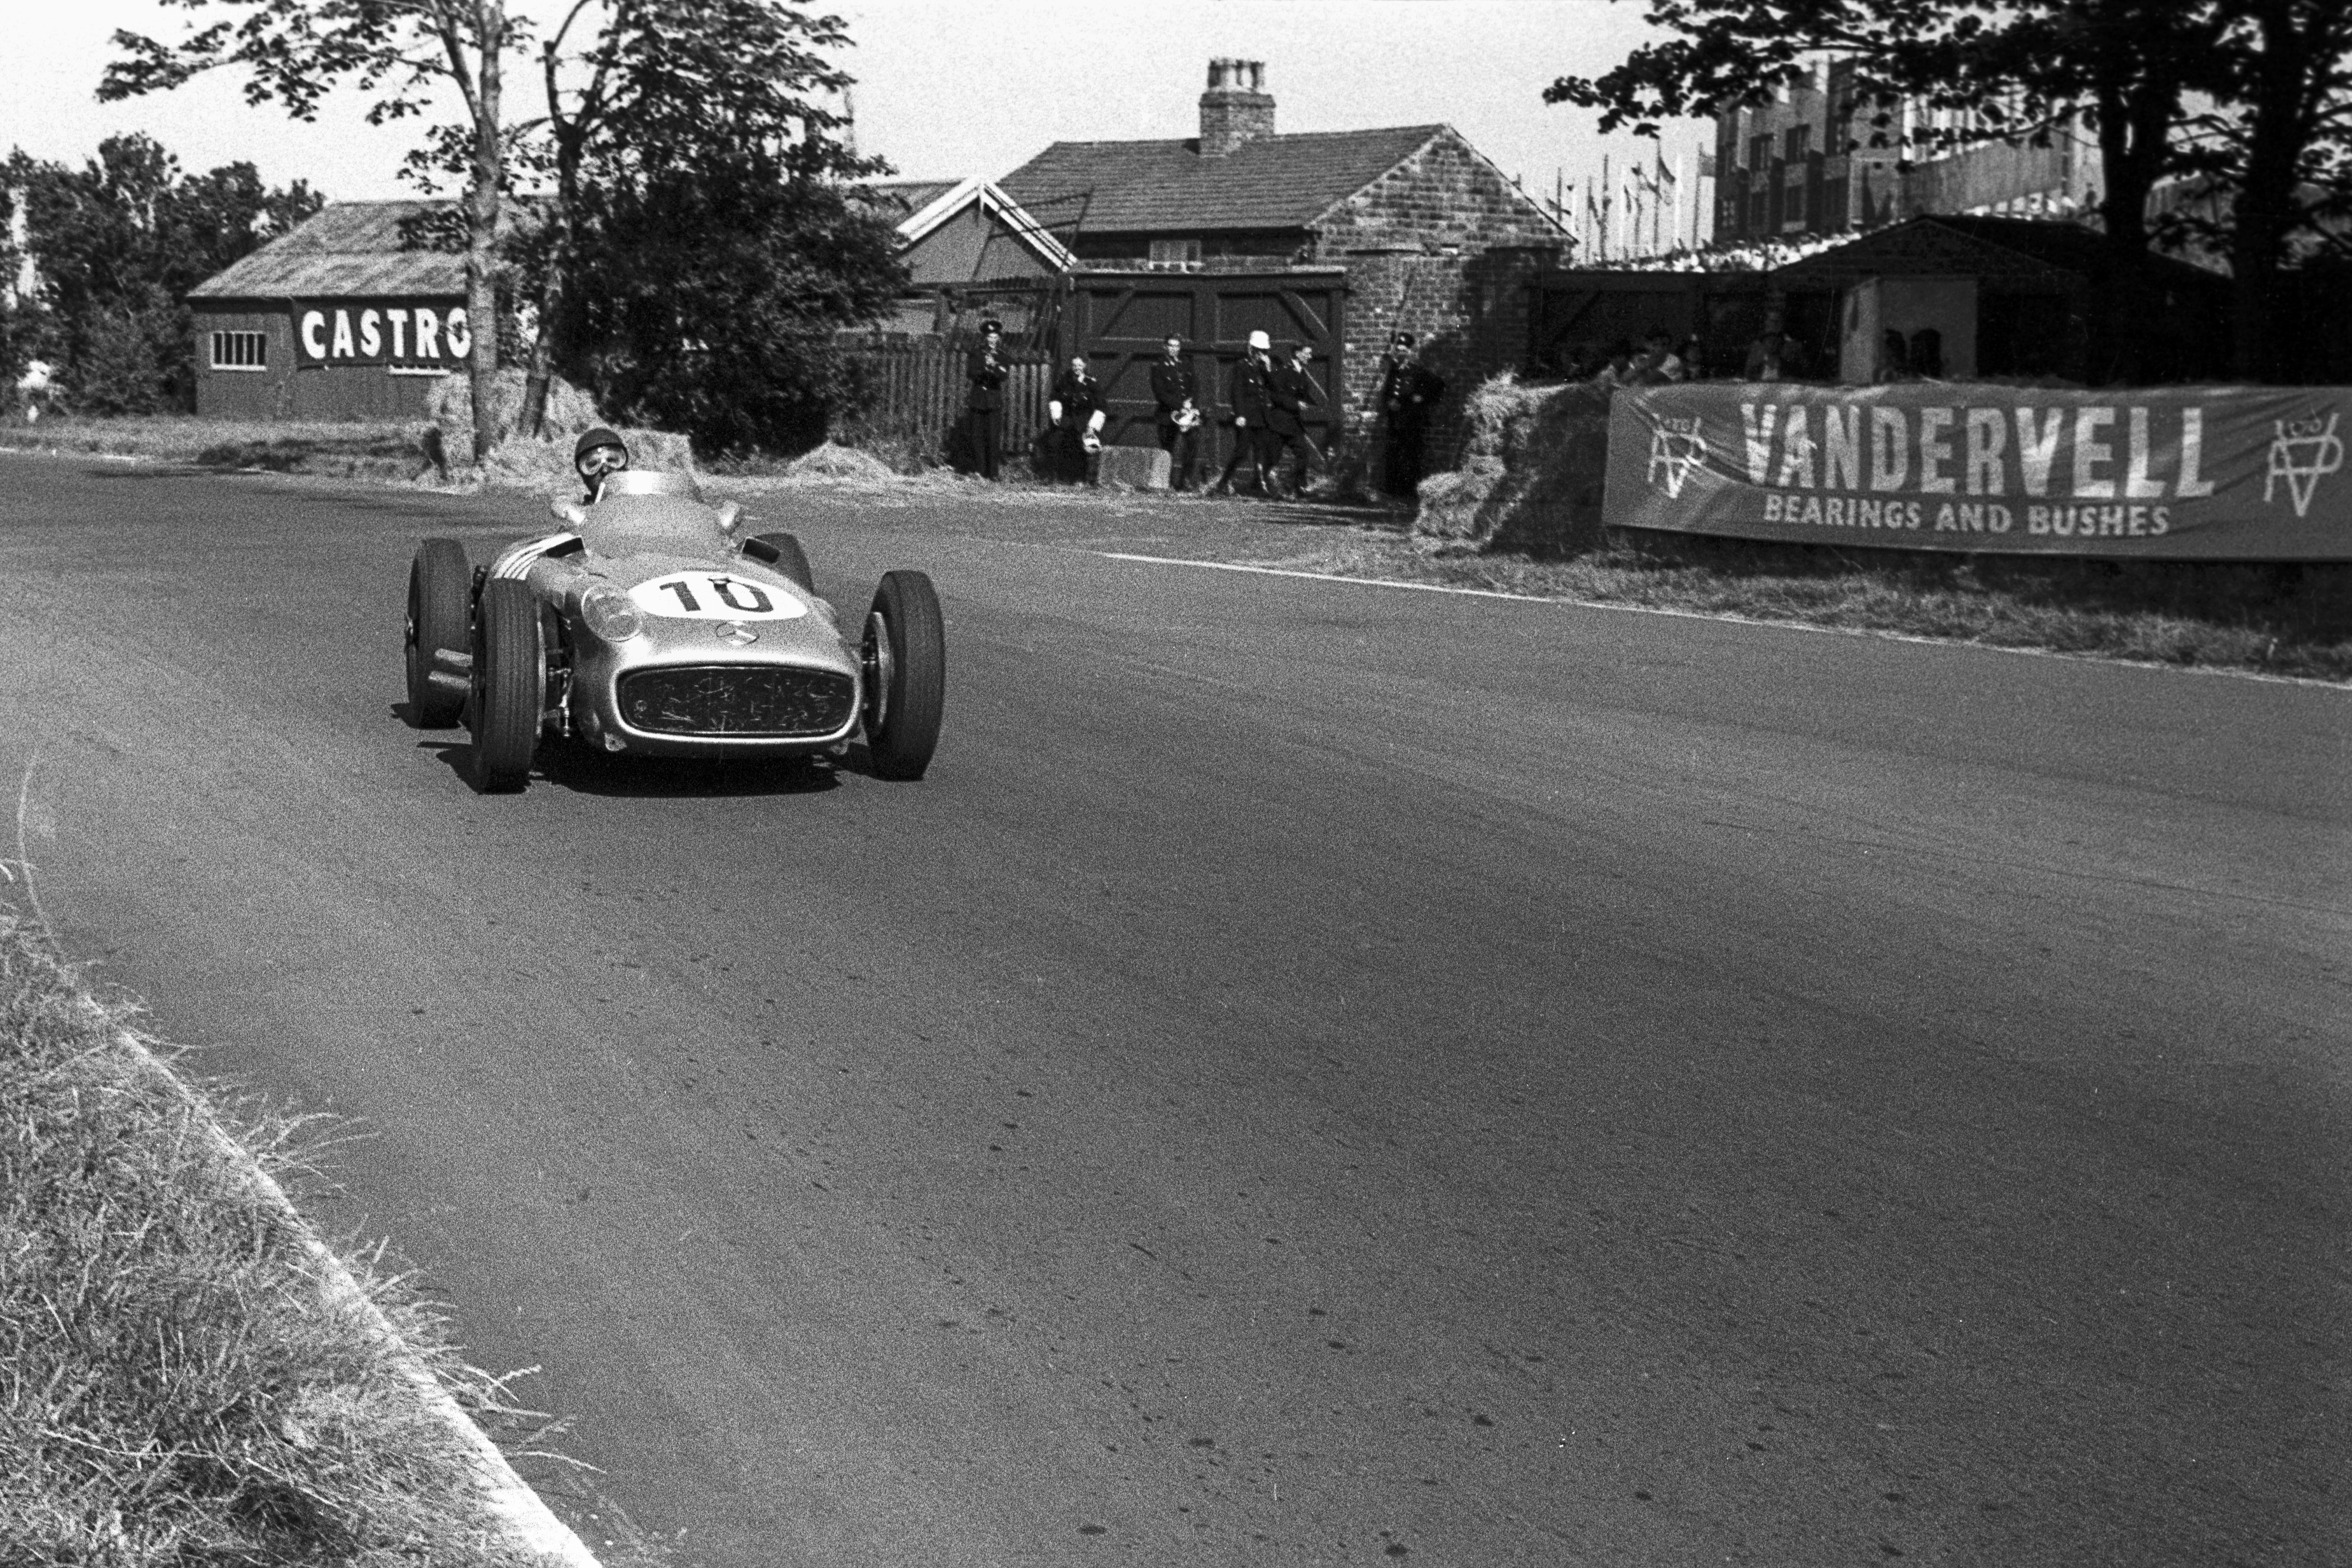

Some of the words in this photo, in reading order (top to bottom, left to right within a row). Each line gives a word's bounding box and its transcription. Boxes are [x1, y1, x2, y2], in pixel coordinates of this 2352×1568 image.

[302, 308, 471, 358] CASTRO
[1741, 404, 2215, 497] VANDERVELL
[1764, 494, 1921, 529] BEARINGS
[1935, 503, 2012, 533] AND
[2028, 506, 2171, 536] BUSHES
[659, 580, 774, 613] 10
